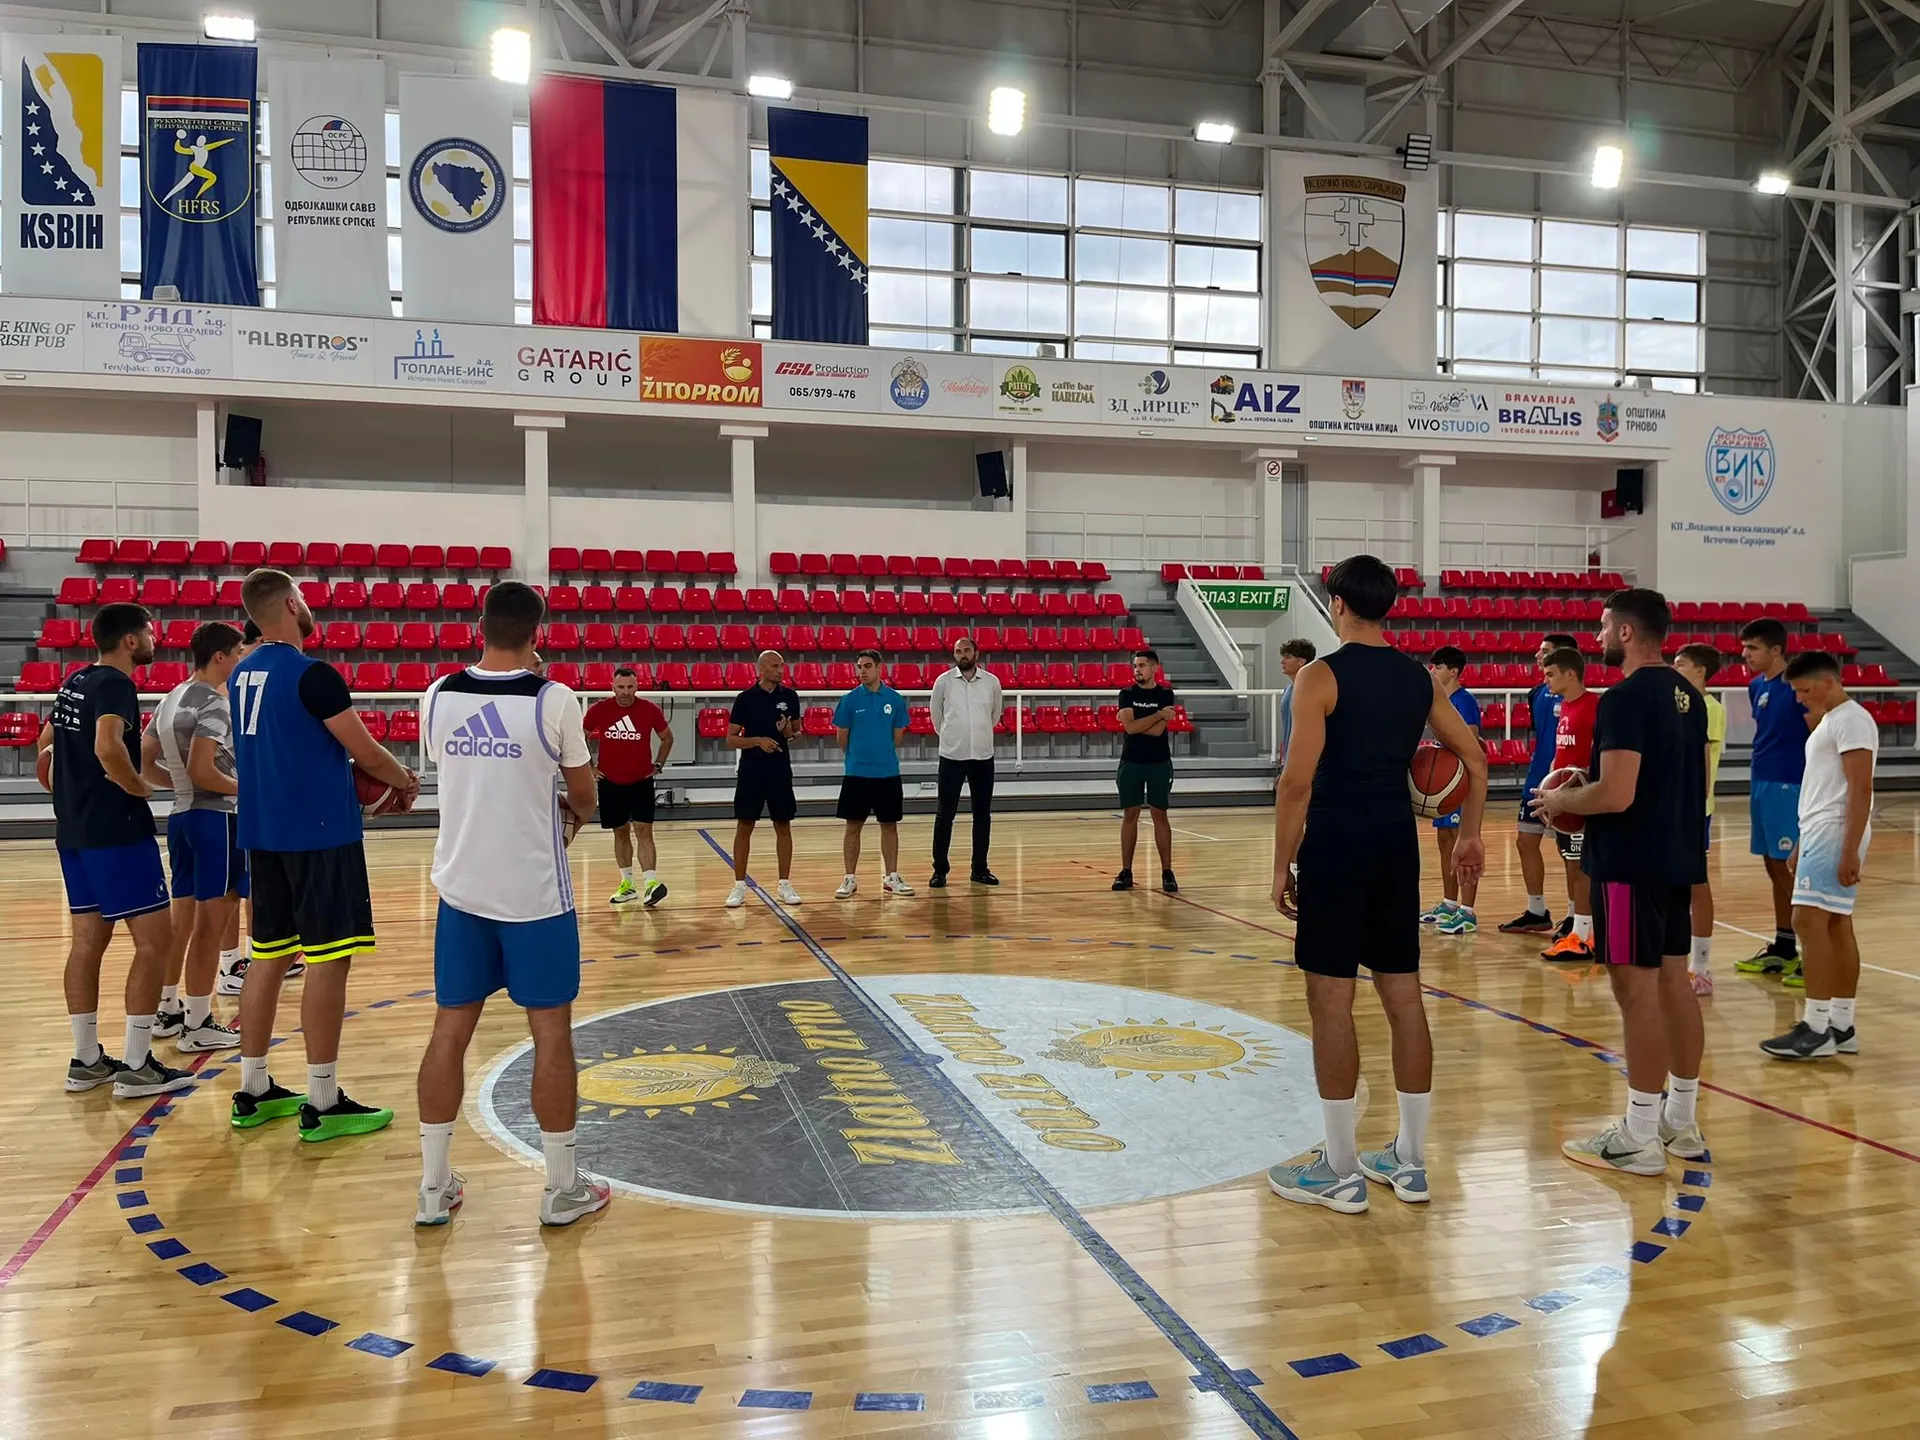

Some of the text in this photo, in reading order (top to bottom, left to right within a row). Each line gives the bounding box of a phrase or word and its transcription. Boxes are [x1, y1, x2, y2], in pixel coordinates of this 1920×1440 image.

[178, 200, 220, 215] HFRS
[285, 200, 376, 213] ОДБОЈКАШКИ САВЕЗ
[287, 215, 376, 228] РЕПУБЛИКЕ СРПСКЕ
[20, 212, 104, 249] KSBIH
[14, 321, 50, 334] KING
[54, 323, 76, 335] OF
[91, 322, 140, 331] ИСТОЧНО
[144, 325, 173, 333] НОВО
[34, 335, 66, 348] PUB
[517, 347, 632, 372] GATARIĆ
[154, 365, 211, 376] 057/340-807
[401, 363, 494, 378] ТОПЛАНЕ-ИНС
[815, 363, 870, 375] Production
[518, 369, 632, 387] GROUP
[642, 376, 760, 403] ŽITOPROM
[789, 386, 856, 399] 065/979-476
[1052, 381, 1094, 391] caffe bar
[894, 387, 925, 399] POPEYE
[1052, 391, 1095, 404] HARIZMA
[1505, 393, 1576, 405] BRAVARIJA
[1108, 398, 1128, 413] ЗД
[1626, 407, 1666, 419] ОПШТИНА
[1309, 420, 1342, 430] ОПШТИНА
[1344, 422, 1373, 432] ИСТОЧНА
[1626, 420, 1658, 432] ТРНОВО
[1671, 522, 1683, 531] КП
[1240, 591, 1271, 604] EXIT
[235, 670, 269, 735] 17
[604, 729, 641, 741] adidas
[445, 737, 522, 759] adidas
